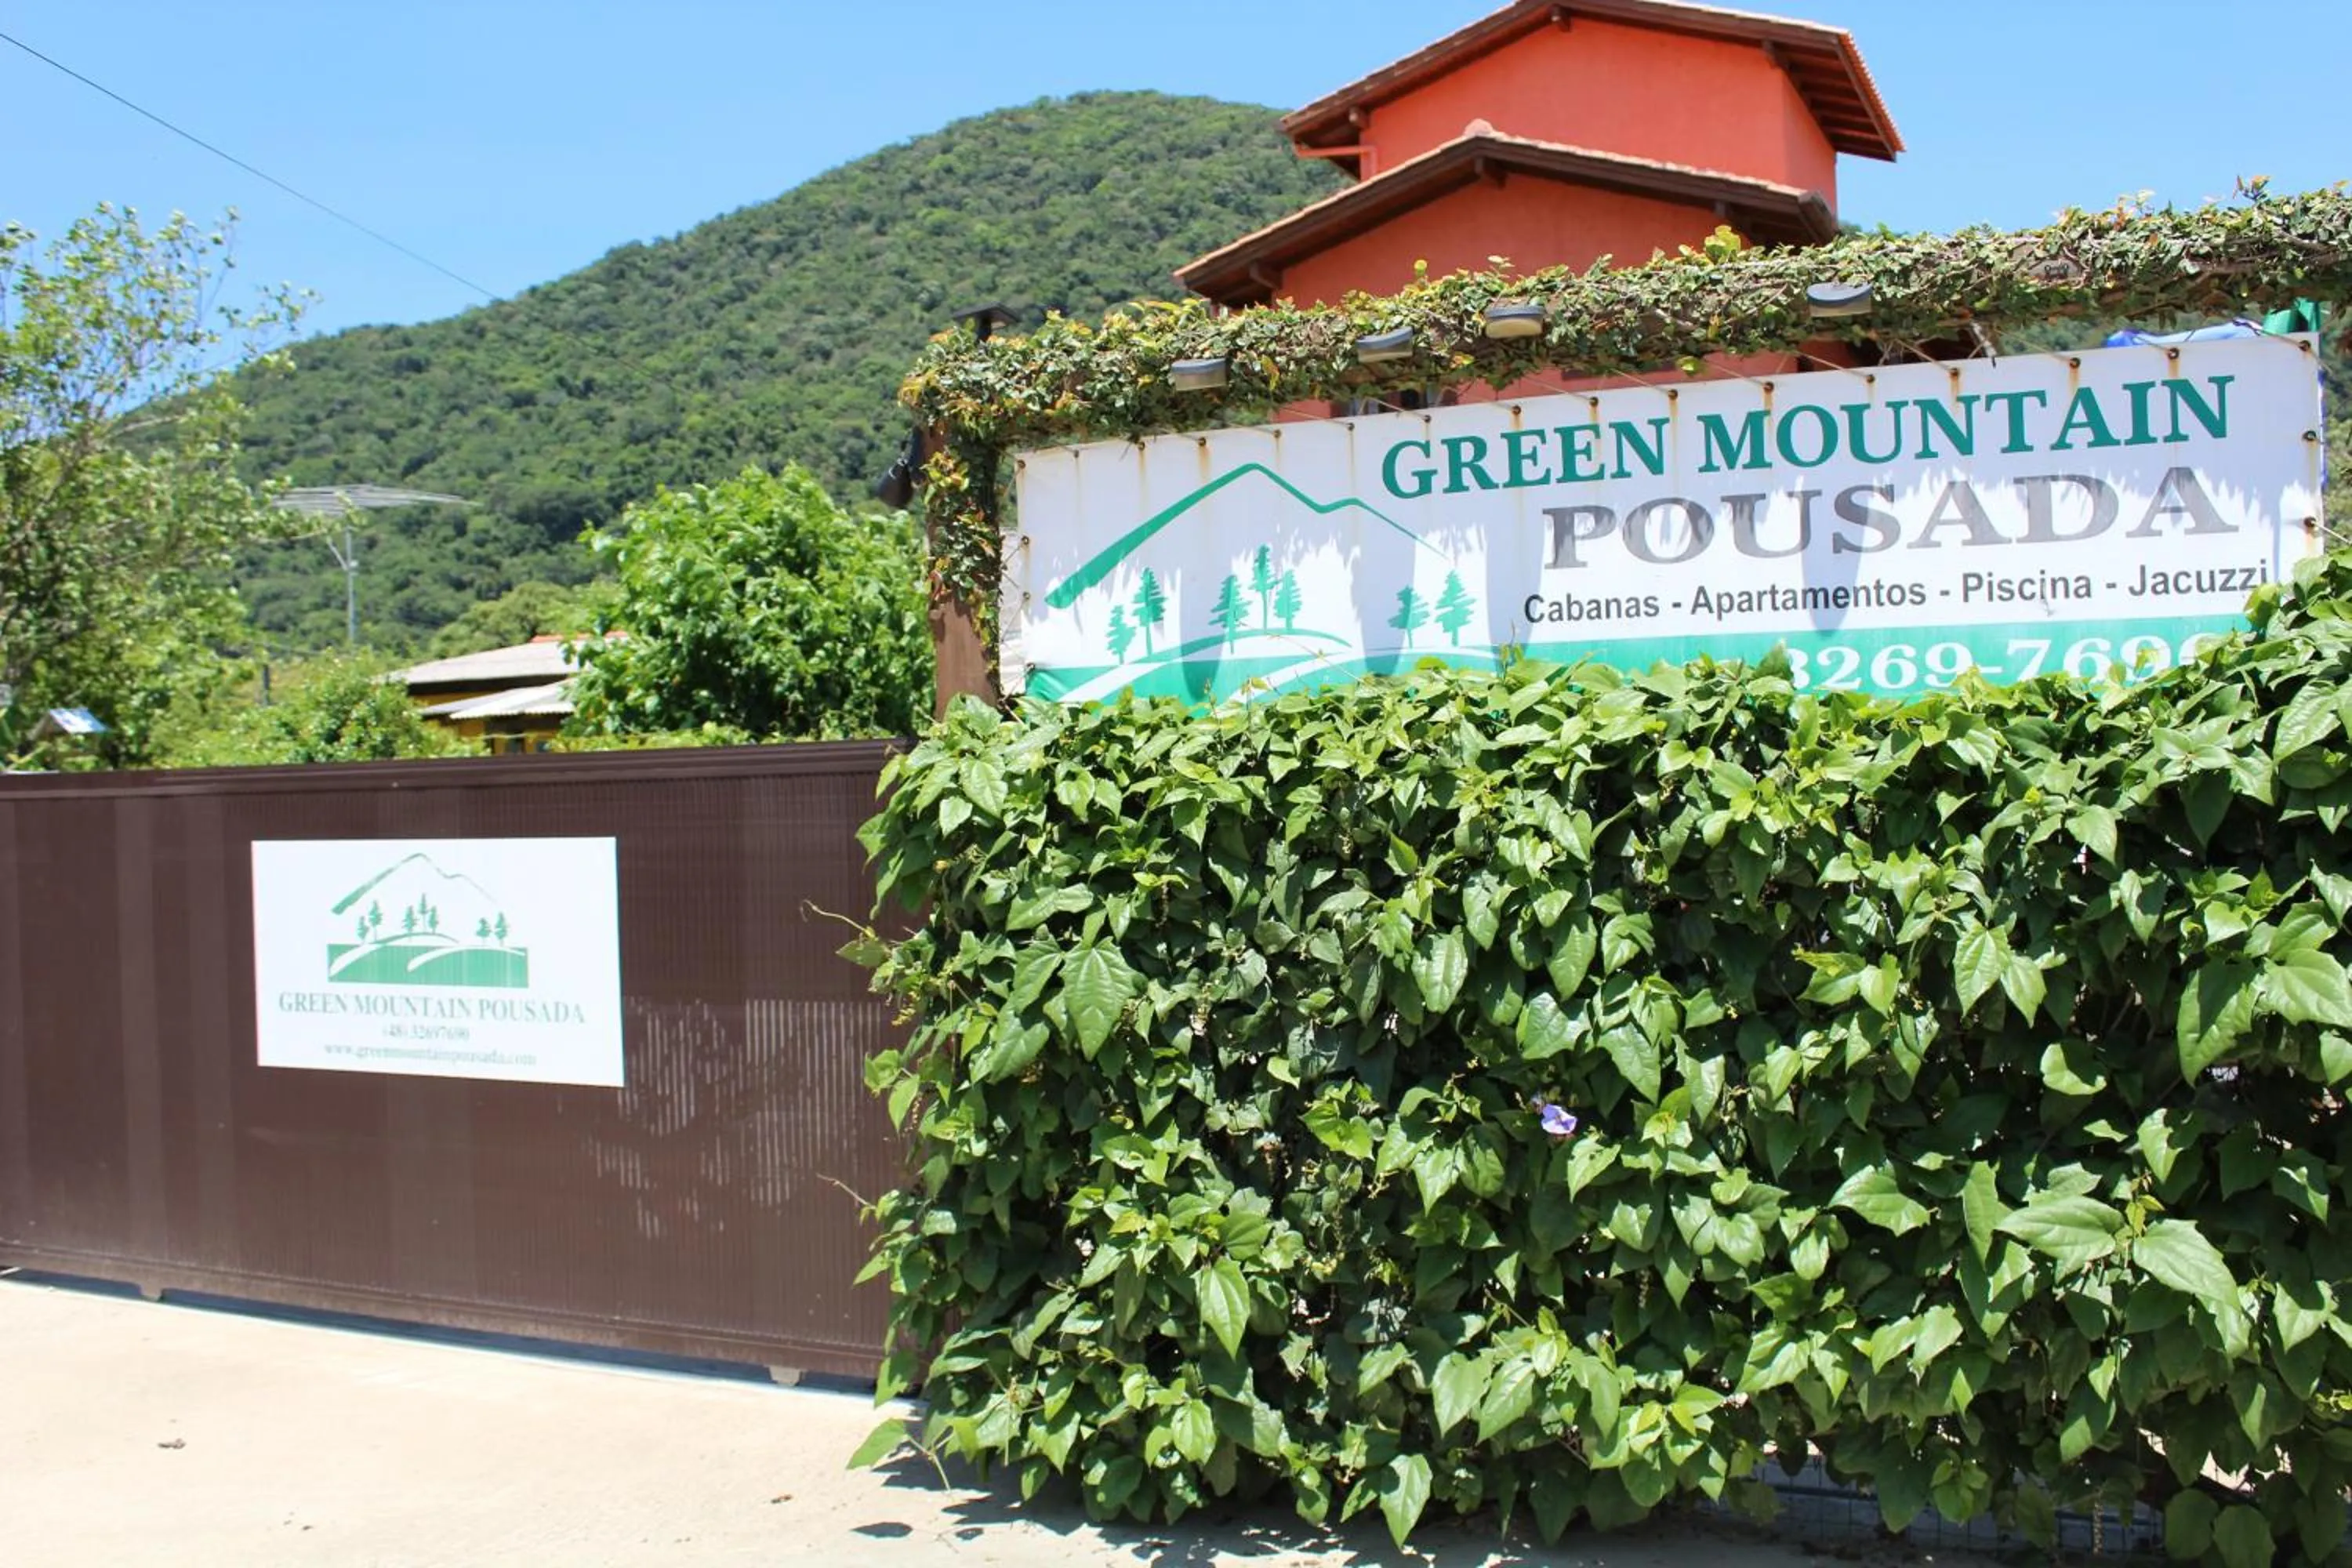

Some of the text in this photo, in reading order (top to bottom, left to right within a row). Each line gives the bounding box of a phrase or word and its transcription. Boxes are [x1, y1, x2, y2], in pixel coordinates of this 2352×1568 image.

[1381, 375, 2235, 500] GREEN MOUNTAIN
[1541, 466, 2240, 570] POUSADA
[1523, 591, 1661, 624] Cabanas
[1690, 578, 1927, 622] Apartamentos
[1962, 568, 2092, 604] Piscina
[2128, 558, 2267, 597] Jacuzzi
[278, 991, 586, 1025] GREEN MOUNTAIN POUSADA
